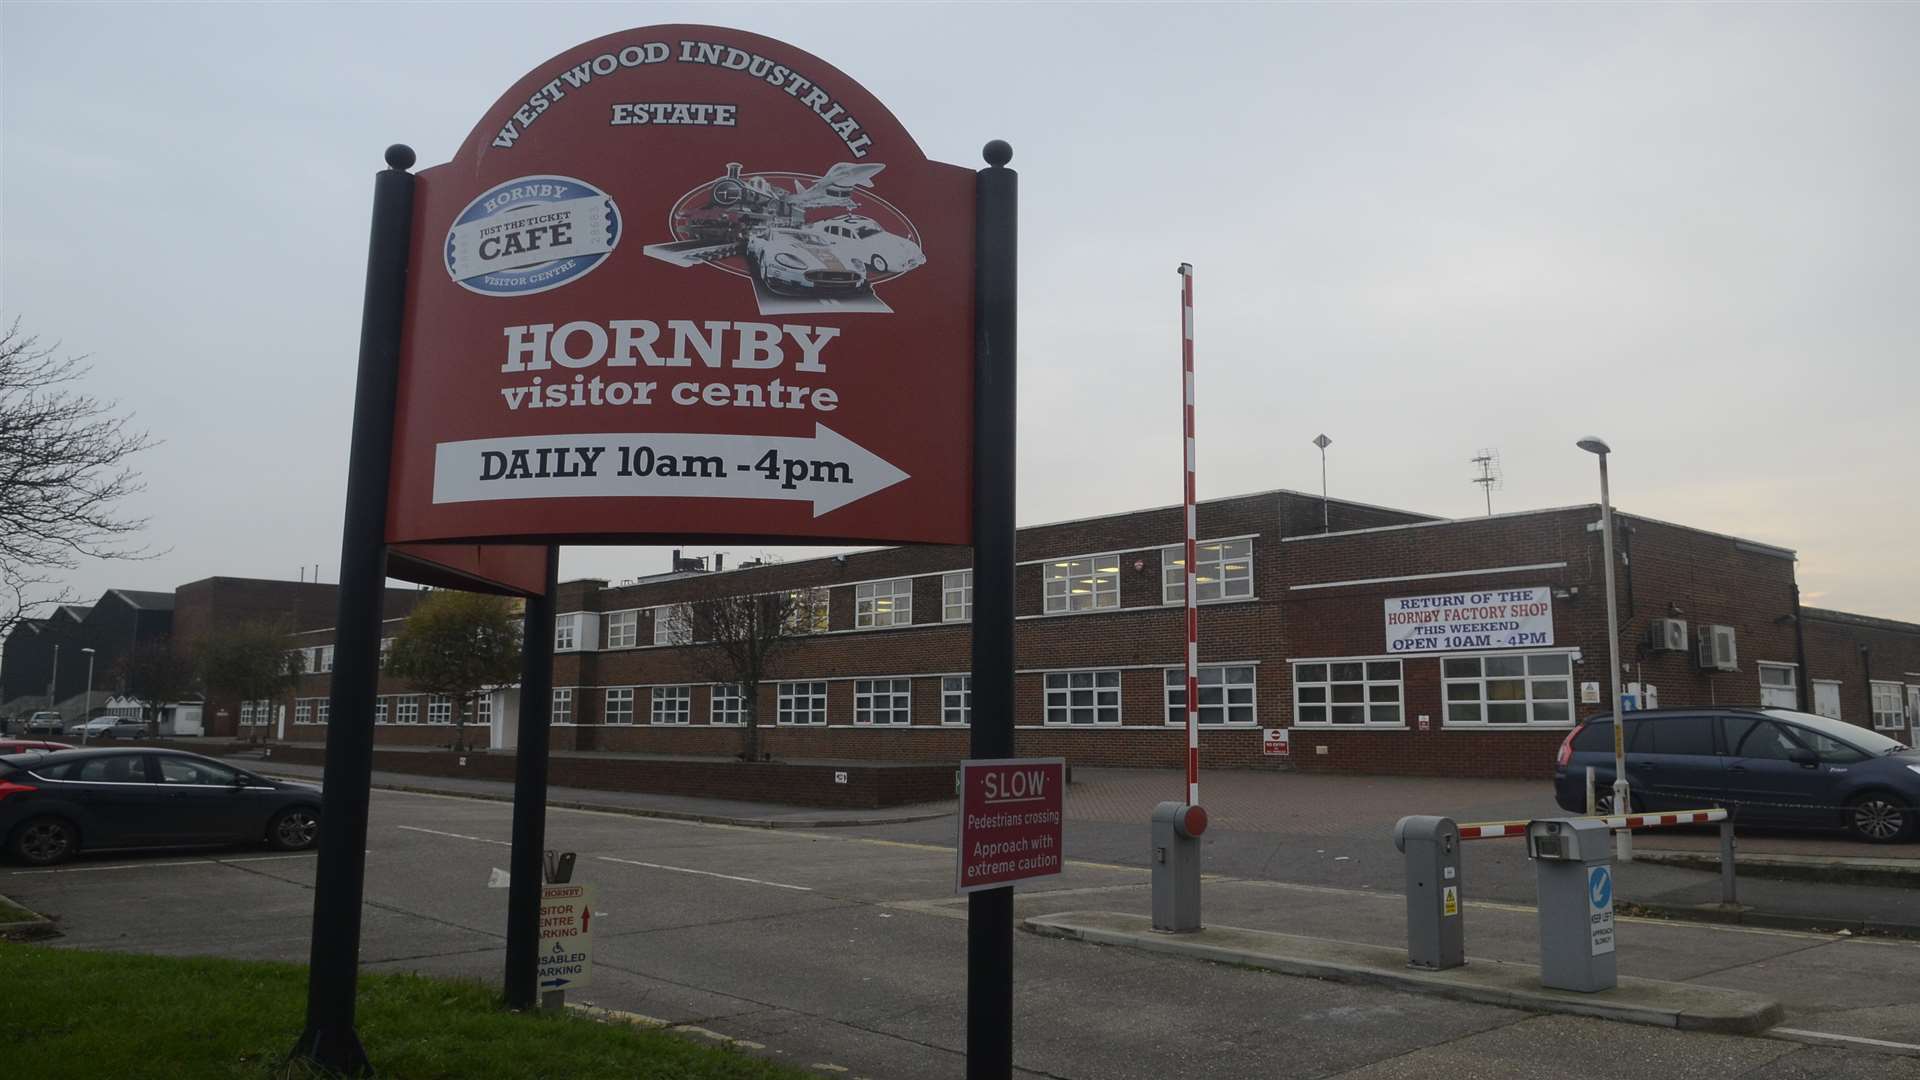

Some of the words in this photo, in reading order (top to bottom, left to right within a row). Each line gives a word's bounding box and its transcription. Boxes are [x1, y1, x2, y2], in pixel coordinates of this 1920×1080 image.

[492, 42, 670, 148] WESTWOOD
[679, 41, 872, 158] INDUSTRIAL
[611, 103, 736, 125] ESTATE
[482, 184, 568, 213] HORNBY
[480, 223, 502, 239] JUST
[503, 219, 525, 231] THE
[526, 211, 571, 227] TICKET
[479, 220, 572, 261] CAFÉ
[484, 274, 528, 287] VISITOR
[529, 259, 577, 284] CENTRE
[501, 319, 841, 374] HORNBY
[501, 374, 657, 412] visitor
[671, 376, 840, 412] centre
[478, 446, 606, 483] DAILY
[615, 446, 727, 478] 10am
[1400, 595, 1465, 610] RETURN
[1470, 593, 1493, 604] OF
[1496, 590, 1533, 602] THE
[1388, 610, 1440, 625] HORNBY
[1444, 606, 1508, 622] FACTORY
[1511, 603, 1548, 617] SHOP
[1392, 637, 1438, 650] OPEN
[1444, 635, 1491, 648] 10AM
[1508, 632, 1546, 646] 4PM
[1414, 624, 1446, 636] THIS
[1450, 621, 1519, 634] WEEKEND
[985, 771, 1044, 798] SLOW
[968, 811, 1022, 829] Pedestrians
[1024, 809, 1059, 824] crossing
[973, 837, 1028, 858] Approach
[1031, 834, 1053, 849] with
[968, 860, 1016, 877] extreme
[1018, 854, 1057, 870] caution
[541, 904, 573, 916] SITOR
